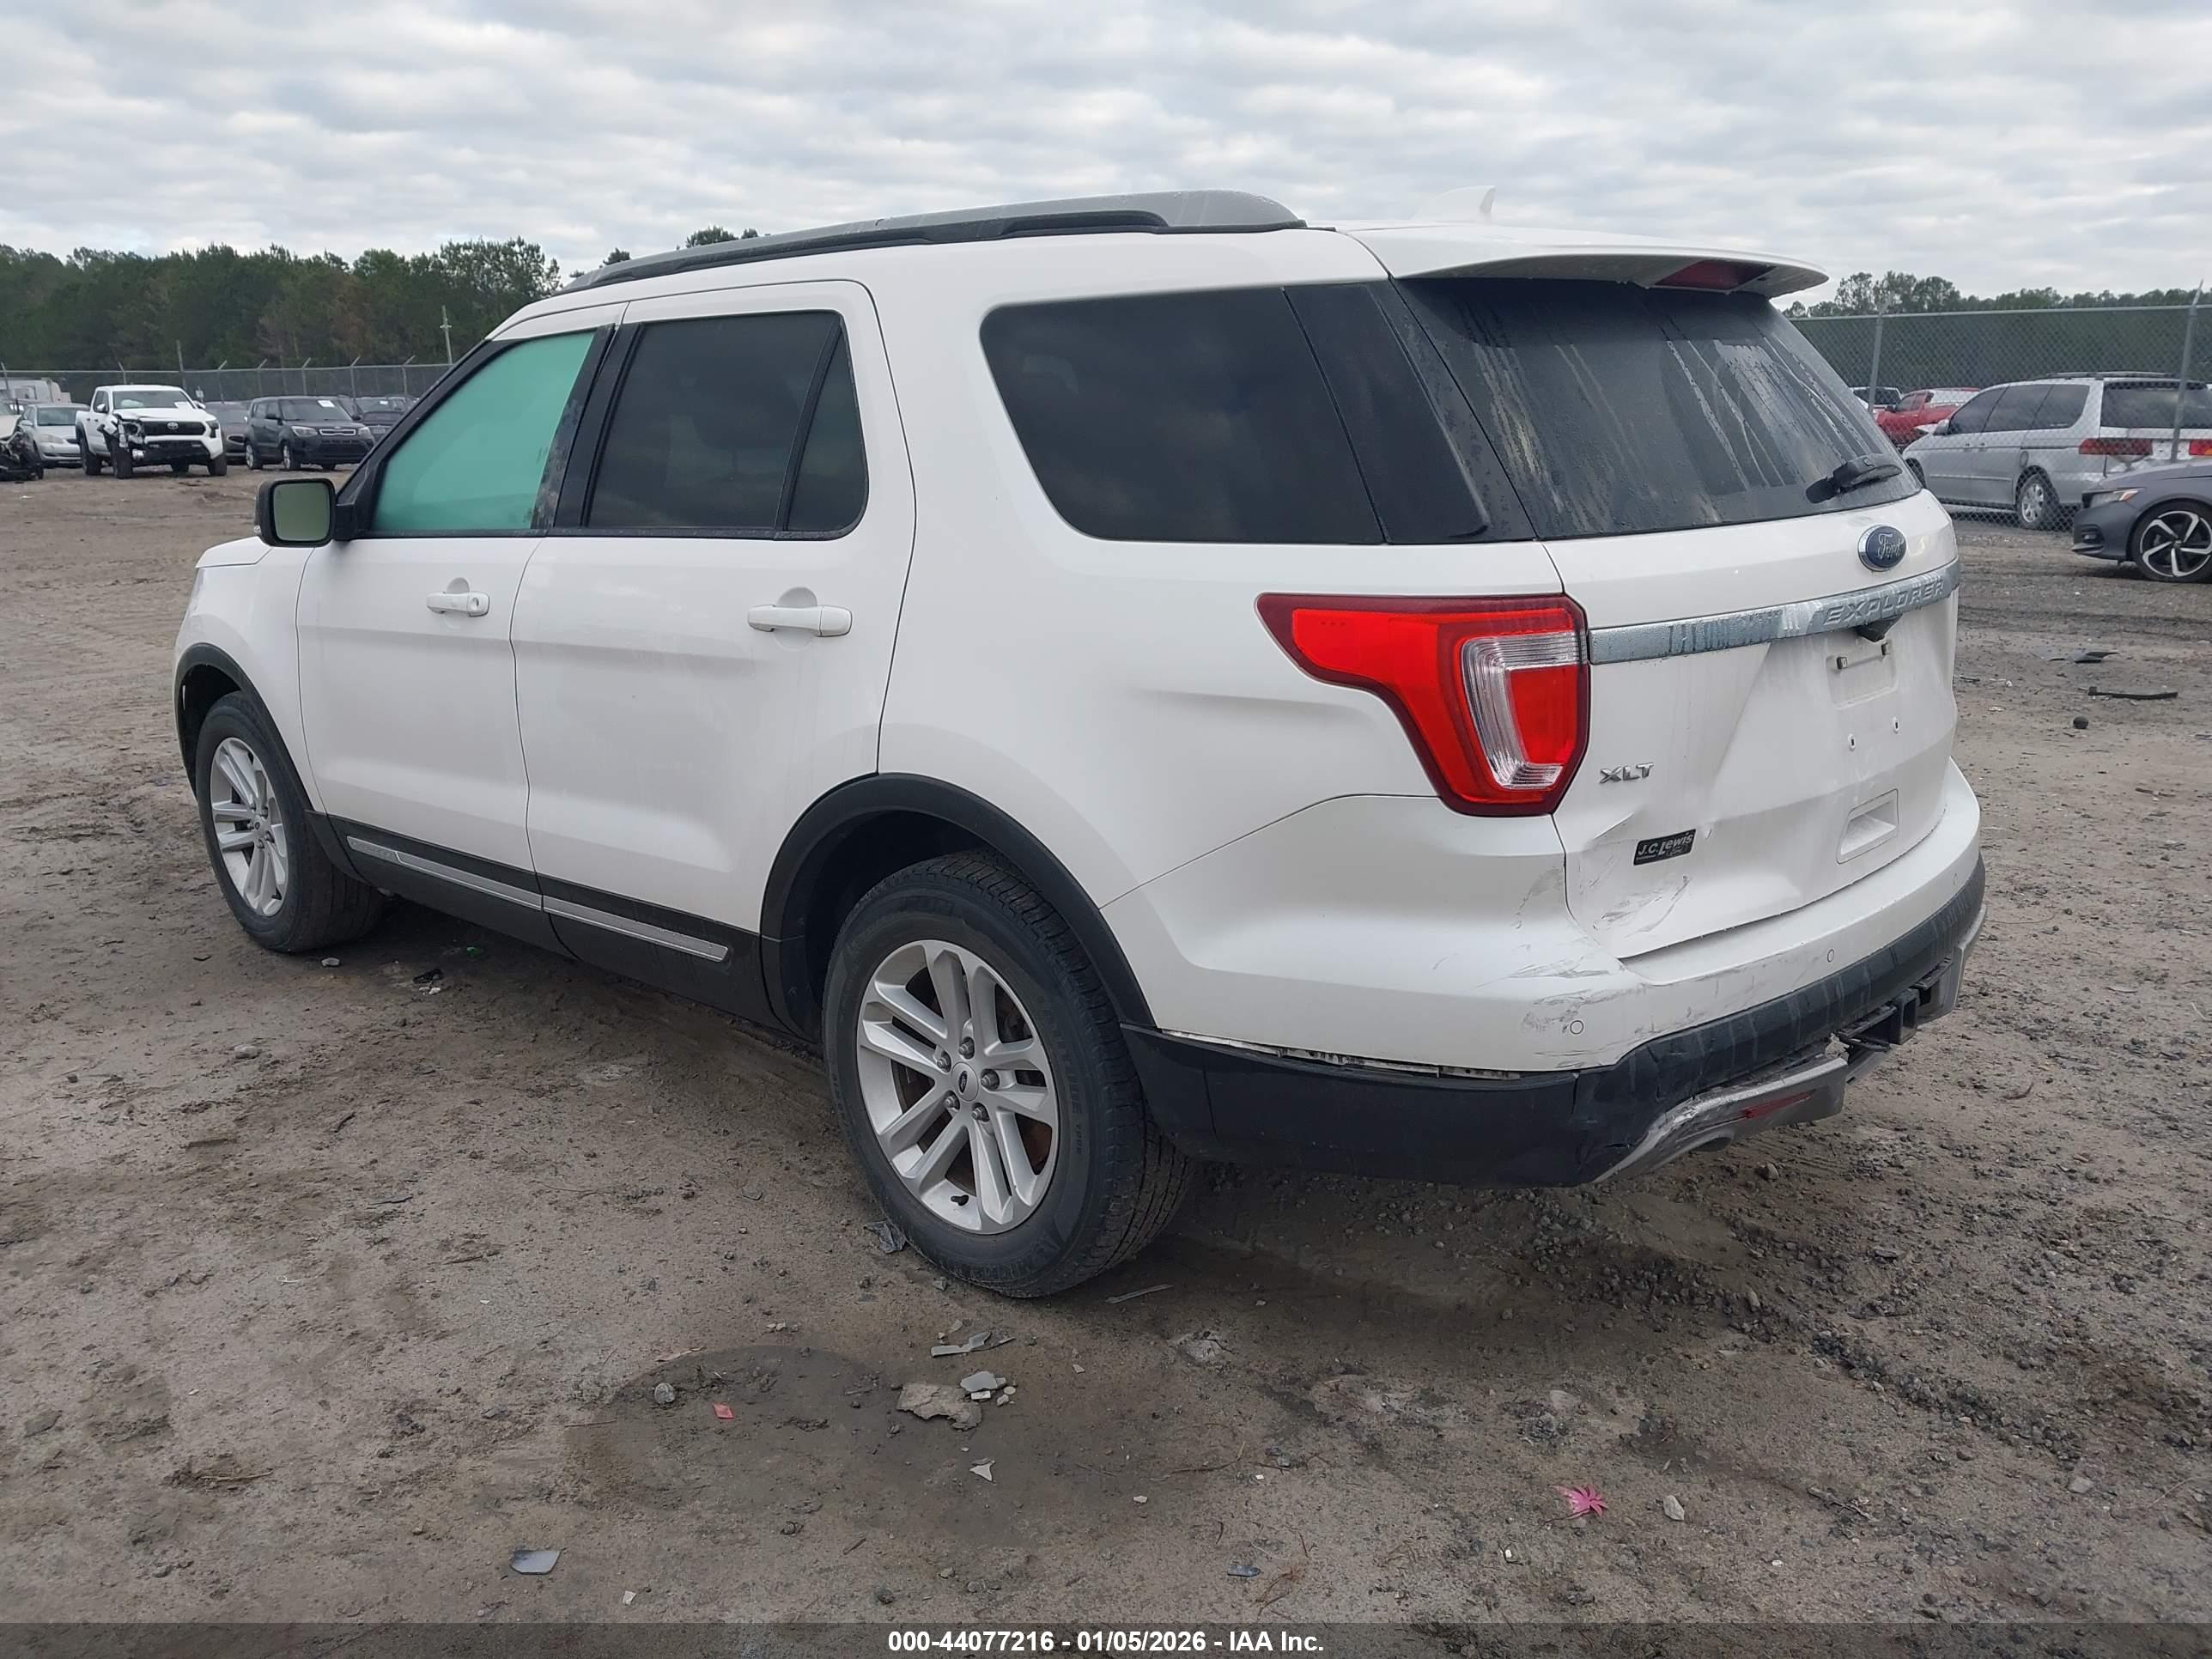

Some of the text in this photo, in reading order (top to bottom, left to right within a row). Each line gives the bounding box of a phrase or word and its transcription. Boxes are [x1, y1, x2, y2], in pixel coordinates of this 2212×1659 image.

[1877, 532, 1905, 559] Ford
[1823, 578, 1944, 626] EXPLORER
[1599, 763, 1655, 784] XLT
[1658, 832, 1694, 856] Lewis
